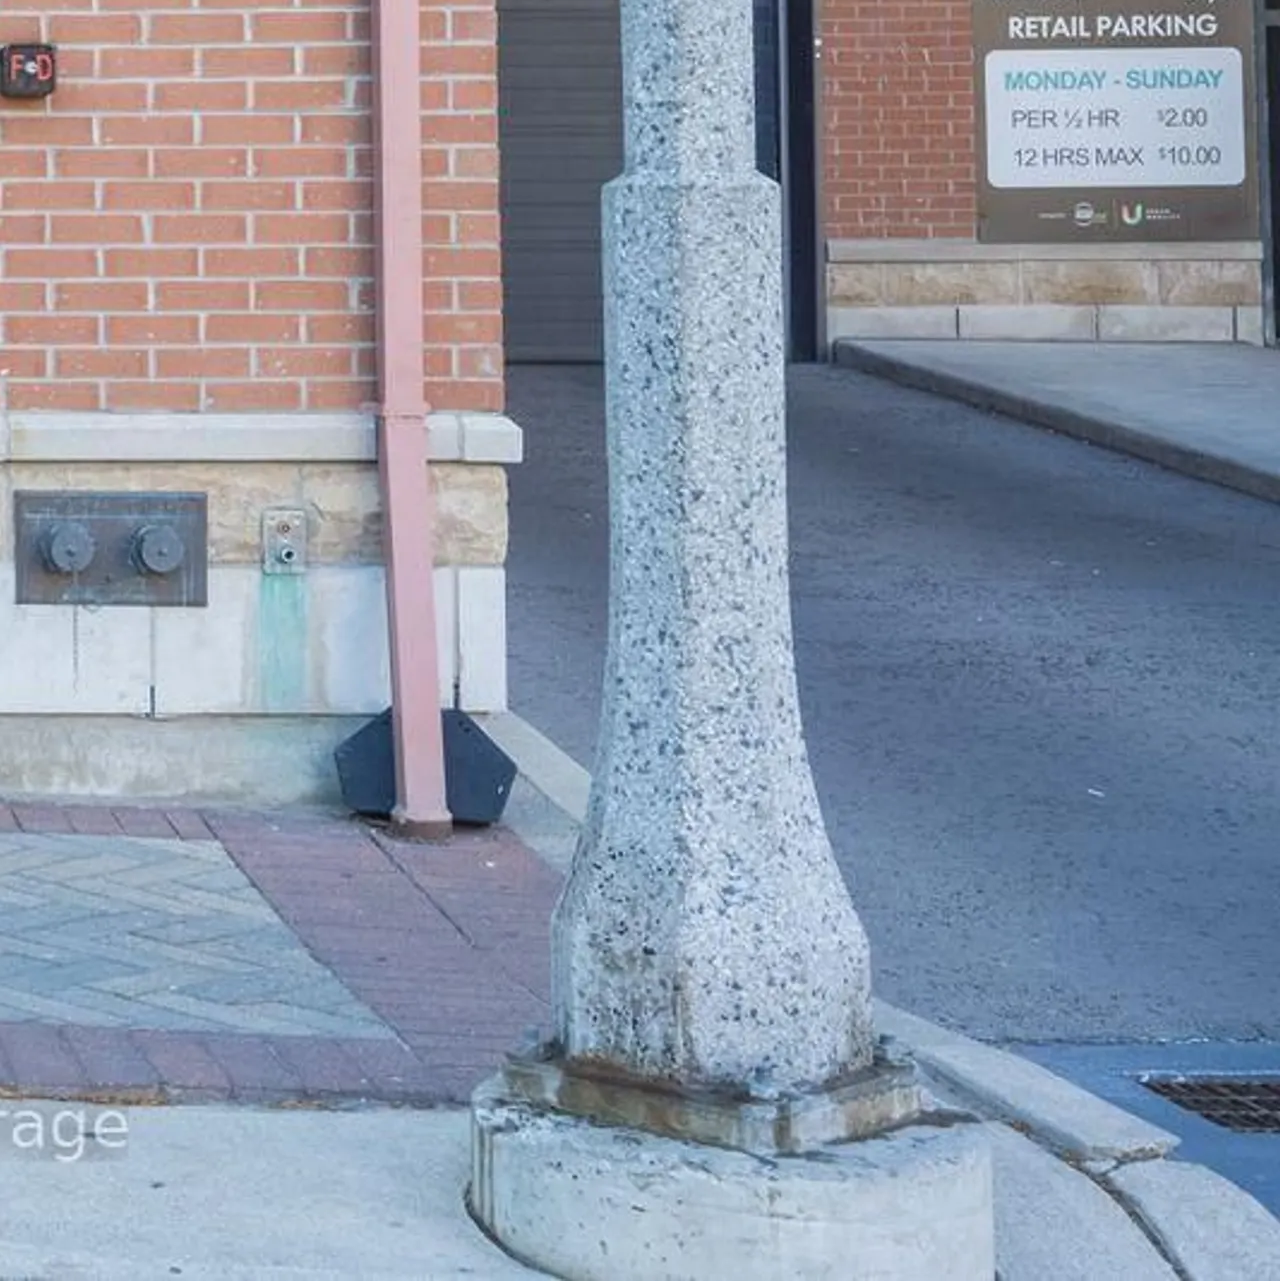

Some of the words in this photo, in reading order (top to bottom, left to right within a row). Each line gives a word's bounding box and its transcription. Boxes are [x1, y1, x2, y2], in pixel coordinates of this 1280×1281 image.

[1008, 16, 1091, 39] RETAIL
[1097, 14, 1218, 37] PARKING
[1003, 70, 1107, 91] MONDAY
[1126, 69, 1224, 89] SUNDAY
[1011, 110, 1058, 128] PER
[1087, 110, 1121, 128] HR
[1157, 108, 1208, 128] $2.00
[1014, 149, 1037, 167] 12
[1042, 148, 1090, 166] HRS
[1096, 147, 1145, 166] MAX
[1158, 146, 1222, 165] $10.00
